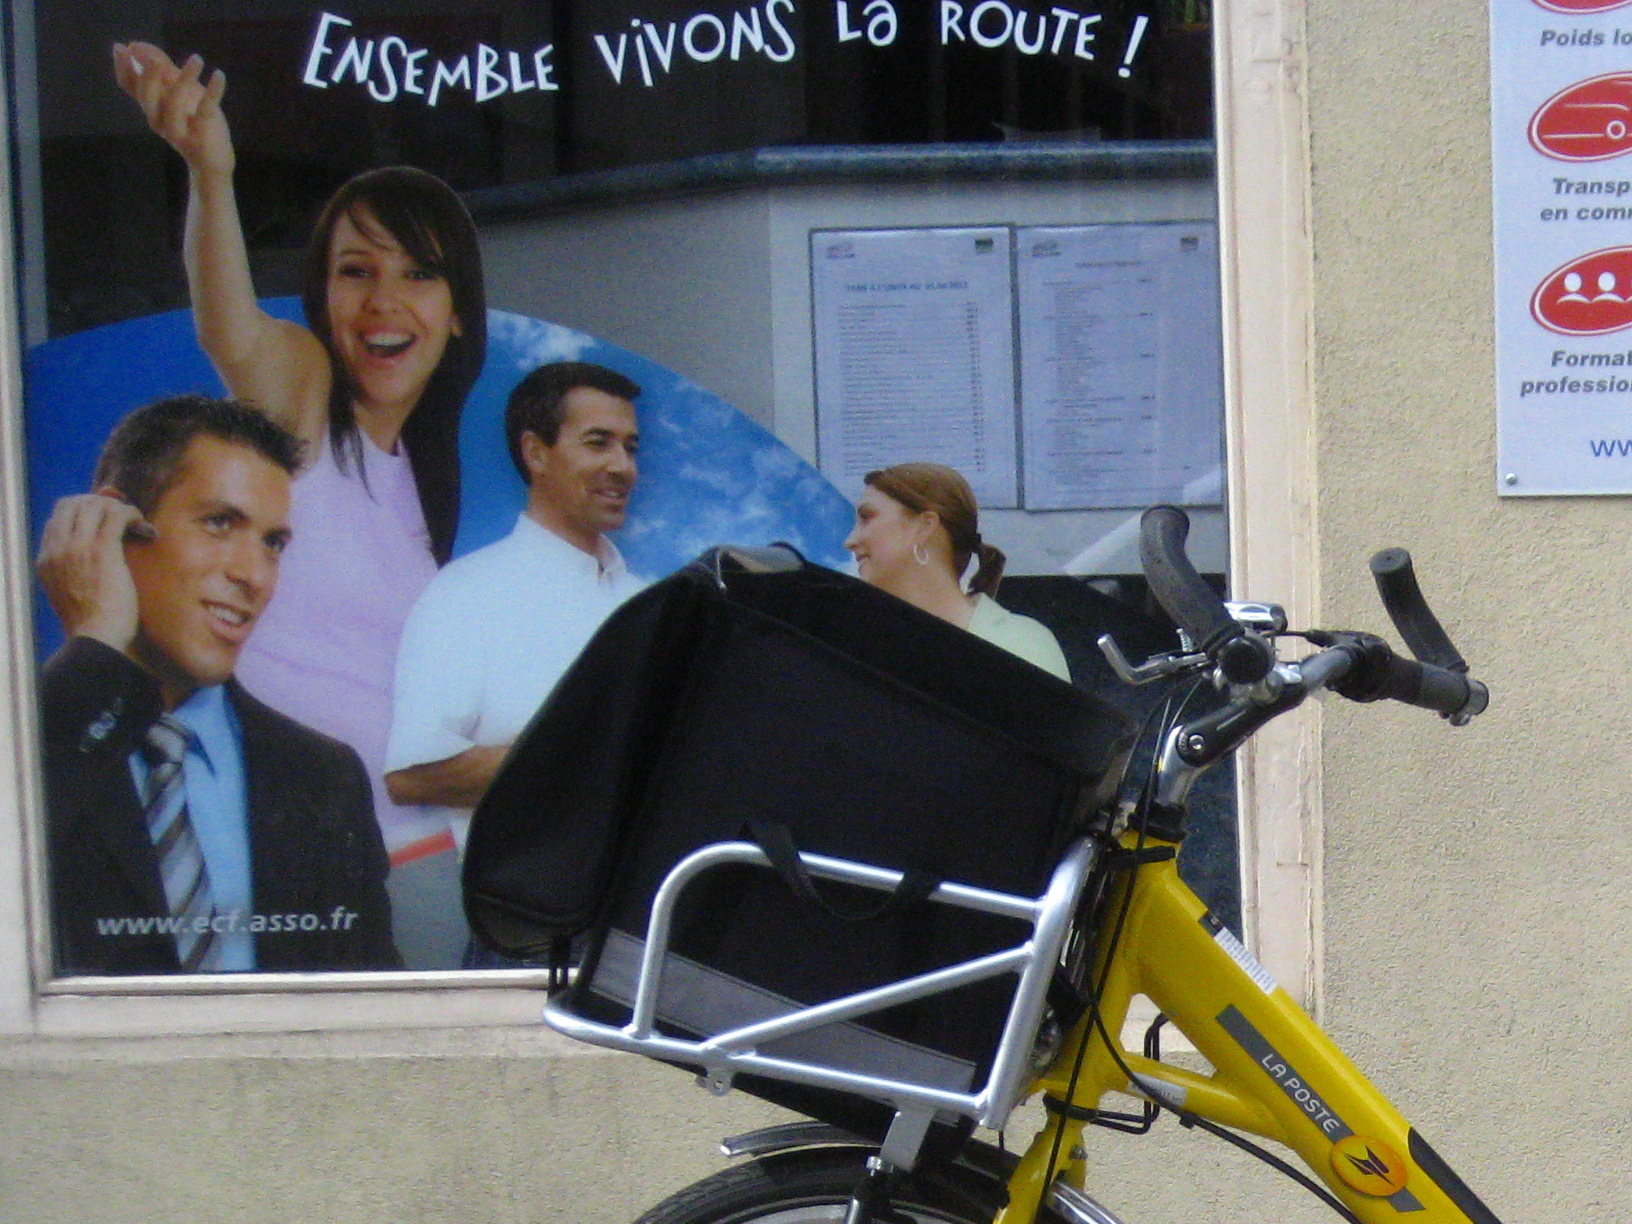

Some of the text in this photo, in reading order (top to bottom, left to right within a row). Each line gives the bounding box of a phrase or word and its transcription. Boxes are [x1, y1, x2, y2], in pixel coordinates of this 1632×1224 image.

[303, 12, 559, 107] ENSEMBLE
[940, 0, 1102, 61] ROUTE
[1540, 28, 1604, 47] Poids
[1540, 206, 1568, 222] en
[97, 904, 360, 936] www.ecf.asso.fr
[1261, 1053, 1341, 1134] LA POSTE
